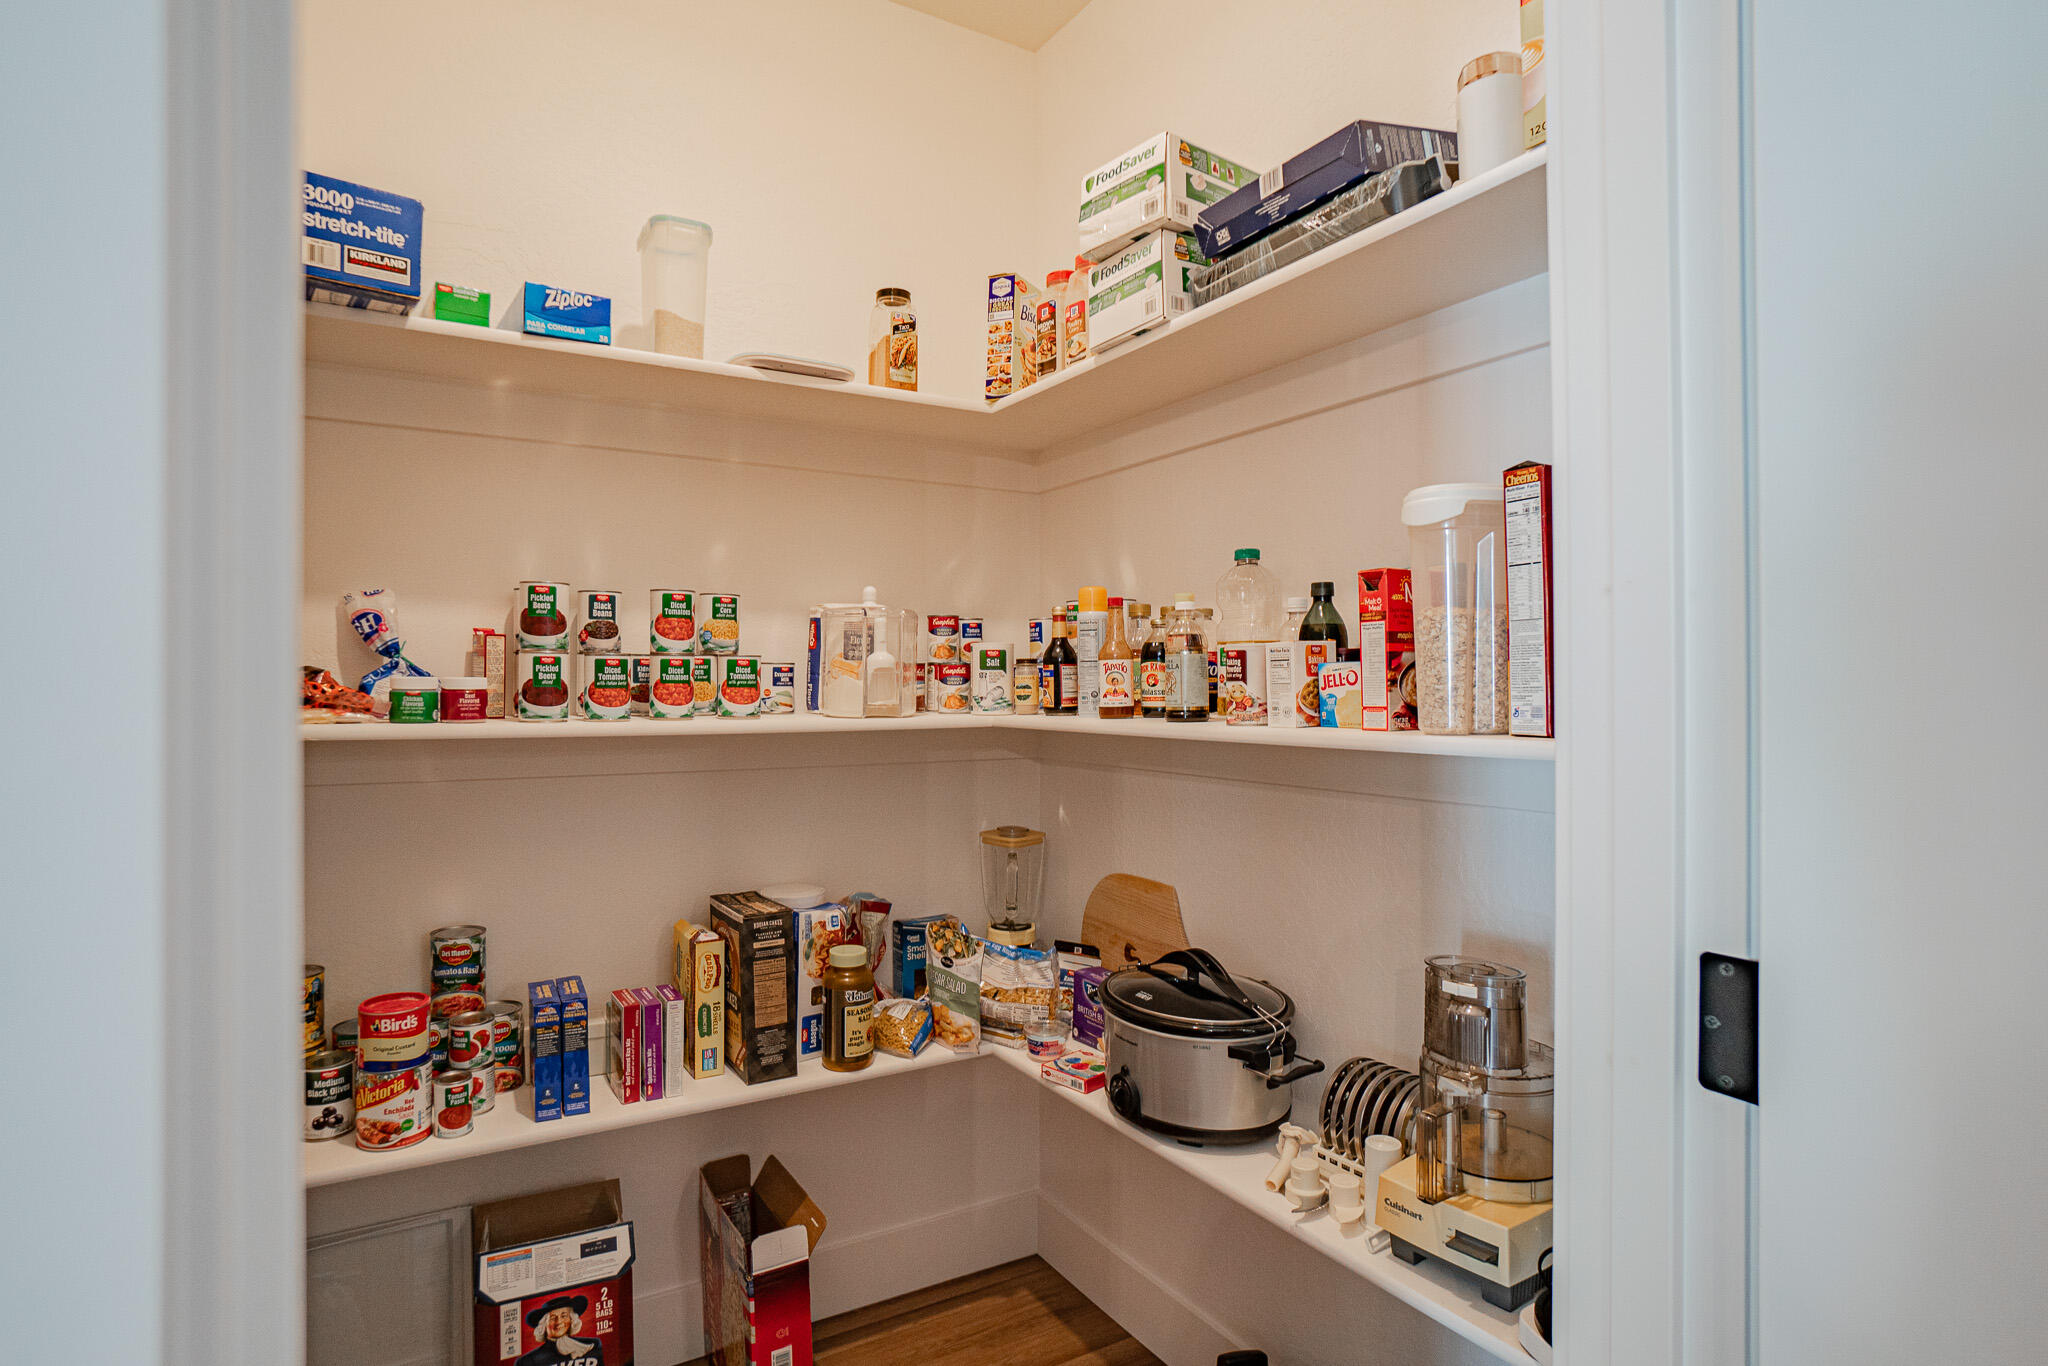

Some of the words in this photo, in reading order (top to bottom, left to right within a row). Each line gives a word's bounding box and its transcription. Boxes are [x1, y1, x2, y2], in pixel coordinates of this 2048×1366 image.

[1095, 144, 1157, 187] FoodSaver
[303, 183, 355, 210] 3000
[303, 211, 406, 250] stretch-tite
[349, 249, 407, 270] KIRKLAND
[1100, 243, 1153, 281] FoodSaver
[545, 288, 593, 310] Ziploc
[1505, 472, 1539, 487] Cheerios
[530, 594, 553, 602] Pickled
[594, 602, 612, 610] Black
[593, 609, 612, 617] Beans
[933, 618, 955, 626] Campbell's
[986, 658, 1000, 667] Salt
[943, 666, 966, 675] Campbell's
[598, 673, 626, 681] Tomatoes
[907, 945, 926, 953] Smal
[907, 951, 926, 961] Shell
[462, 965, 480, 975] Basil
[945, 976, 967, 995] SALAD
[380, 1014, 418, 1032] Bird's
[809, 1020, 817, 1048] Lasagna
[373, 1045, 394, 1053] Original
[495, 1044, 517, 1052] room
[314, 1076, 345, 1089] Medium
[307, 1087, 329, 1098] Black
[360, 1078, 405, 1107] Victoria
[1384, 1197, 1423, 1222] Cuisinart
[600, 1287, 608, 1301] 2
[596, 1302, 601, 1311] 5
[603, 1299, 614, 1309] LB
[596, 1308, 613, 1319] BAGS
